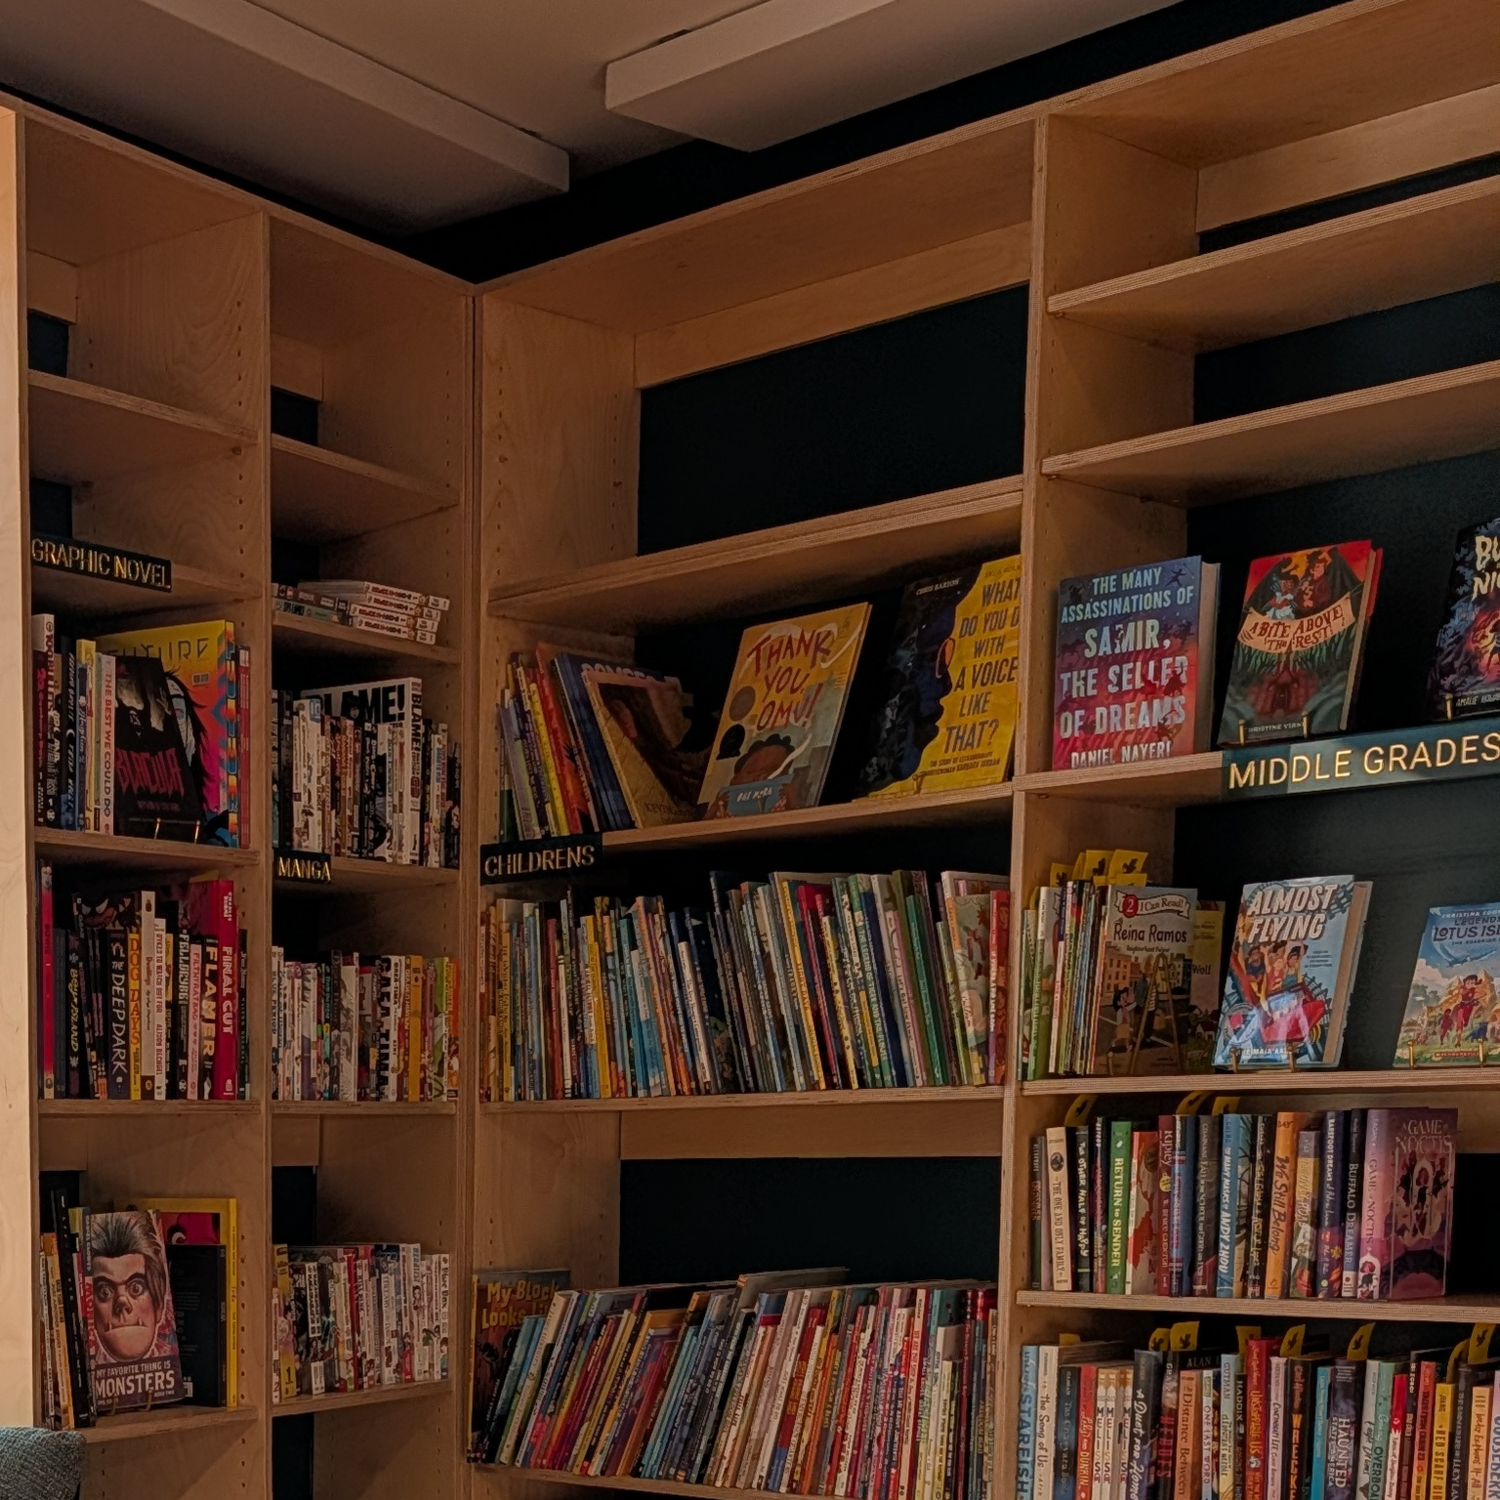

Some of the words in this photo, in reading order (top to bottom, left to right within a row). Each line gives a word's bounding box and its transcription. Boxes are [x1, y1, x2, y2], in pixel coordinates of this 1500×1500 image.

[31, 538, 110, 576] GRAPHIC
[113, 556, 171, 590] NOVEL
[1092, 577, 1118, 596] THE
[1122, 567, 1162, 591] MANY
[1061, 591, 1173, 623] ASSASSINATIONS
[1176, 586, 1194, 606] OF
[1260, 620, 1290, 638] BITE
[1294, 604, 1343, 633] ABOVE
[747, 628, 833, 675] THANK
[972, 636, 1005, 659] WITH
[1084, 619, 1172, 658] SAMIR,
[953, 670, 966, 692] A
[972, 658, 1019, 686] VOICE
[1060, 669, 1099, 700] THE
[1108, 656, 1189, 693] SELLER
[756, 683, 824, 731] OMU!
[958, 692, 991, 718] LIKE
[1060, 708, 1084, 739] OF
[1095, 695, 1186, 733] DREAMS
[104, 730, 112, 750] WE
[944, 719, 999, 754] THAT?
[1071, 748, 1116, 769] DANIEL
[1121, 739, 1172, 763] NAYERI
[1229, 750, 1352, 790] MIDDLE
[1364, 736, 1500, 774] GRADES
[104, 797, 111, 817] DO
[278, 856, 331, 881] MANGA
[485, 845, 595, 877] CHILDRENS
[1248, 884, 1338, 917] ALMOST
[1114, 922, 1144, 943] Reina
[1149, 924, 1187, 943] Ramos
[1248, 913, 1327, 944] FLYING
[111, 961, 124, 970] THE
[130, 937, 139, 982] DOG
[222, 946, 233, 997] FINAL
[112, 974, 126, 1020] DEEP
[203, 945, 217, 1057] FLAMER
[130, 988, 140, 1045] DAYS
[222, 1001, 233, 1035] CUT
[112, 1022, 127, 1074] DARK
[1113, 1157, 1124, 1206] RETURN
[1347, 1163, 1359, 1208] BUFFALO
[1113, 1208, 1120, 1217] to
[1111, 1218, 1122, 1268] SENDER
[1345, 1212, 1356, 1264] DREAMER
[95, 1371, 175, 1398] MONSTERS
[1017, 1393, 1032, 1493] STARFISH
[1335, 1418, 1351, 1488] HAUNTED
